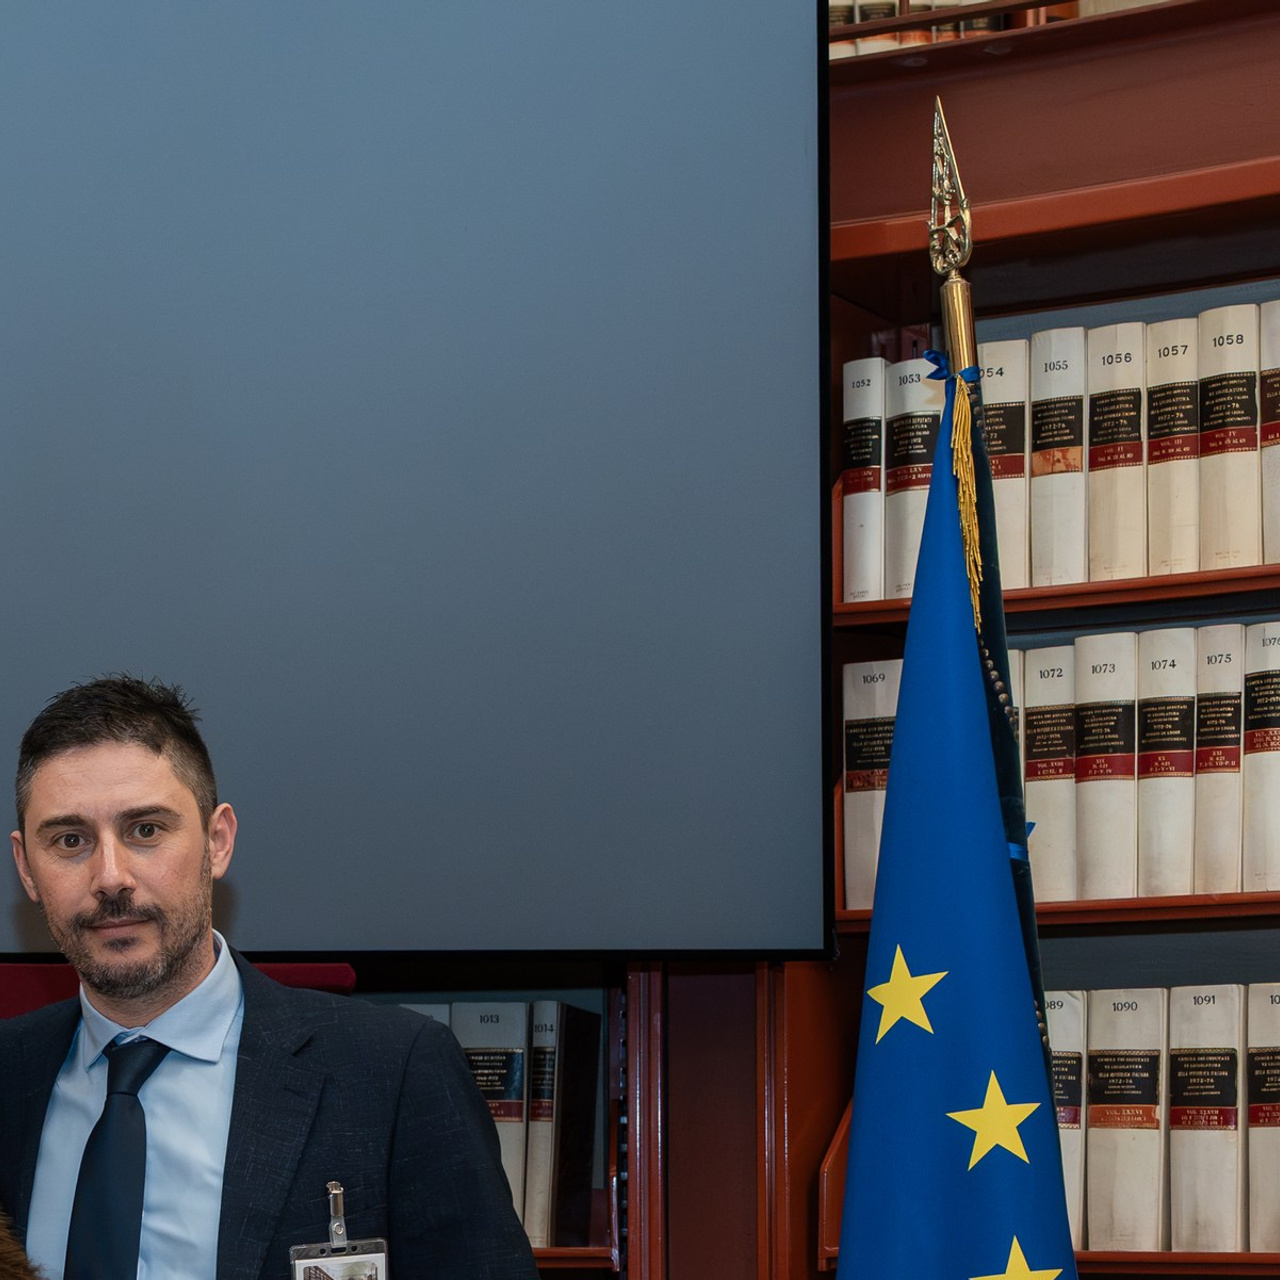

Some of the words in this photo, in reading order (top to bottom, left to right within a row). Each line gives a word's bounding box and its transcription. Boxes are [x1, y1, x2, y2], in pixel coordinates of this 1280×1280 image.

[1213, 334, 1244, 348] 1058
[1158, 345, 1188, 358] 1057
[1102, 352, 1132, 366] 1056
[1043, 360, 1069, 372] 1055
[979, 367, 1005, 379] 054
[852, 379, 871, 389] 1052
[898, 373, 921, 387] 1053
[1151, 659, 1177, 671] 1074
[1206, 653, 1232, 665] 1075
[1039, 668, 1063, 679] 1072
[1091, 663, 1116, 674] 1073
[862, 673, 885, 684] 1069
[1112, 1001, 1138, 1012] 1090
[1193, 995, 1216, 1006] 1091
[479, 1015, 499, 1024] 1013
